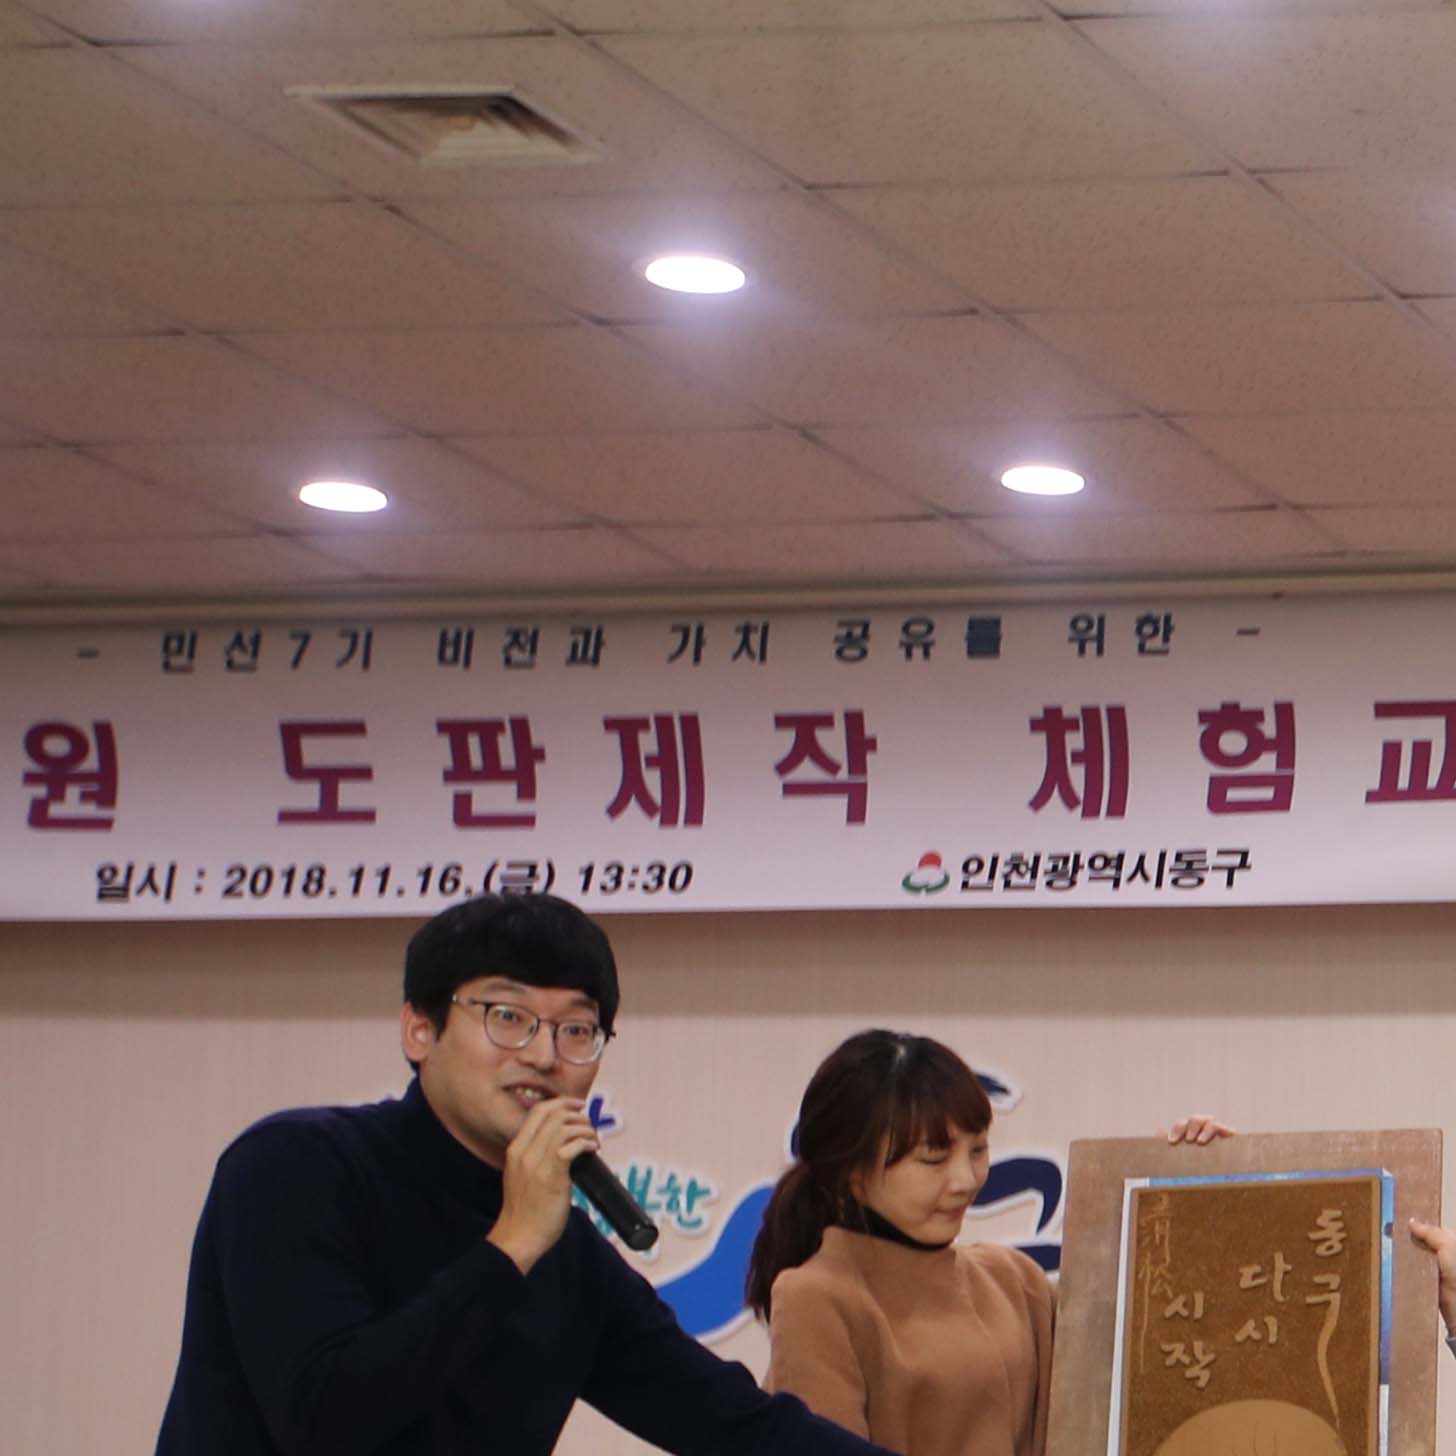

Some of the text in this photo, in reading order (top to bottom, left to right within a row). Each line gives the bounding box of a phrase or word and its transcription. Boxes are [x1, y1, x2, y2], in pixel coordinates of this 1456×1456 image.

[161, 628, 374, 674] 민선7기
[437, 626, 606, 670] 비전과
[666, 621, 770, 666] 가치
[833, 617, 1003, 663] 공유를
[1067, 612, 1175, 657] 위한
[21, 718, 120, 832] 원
[277, 709, 879, 830] 도판제작
[96, 862, 177, 902] 일시
[578, 861, 694, 894] 13:30
[960, 849, 1252, 892] 인천광역시동구
[1160, 1291, 1216, 1387] 시작
[1234, 1251, 1292, 1344] 다시
[1305, 1208, 1348, 1428] 동구
